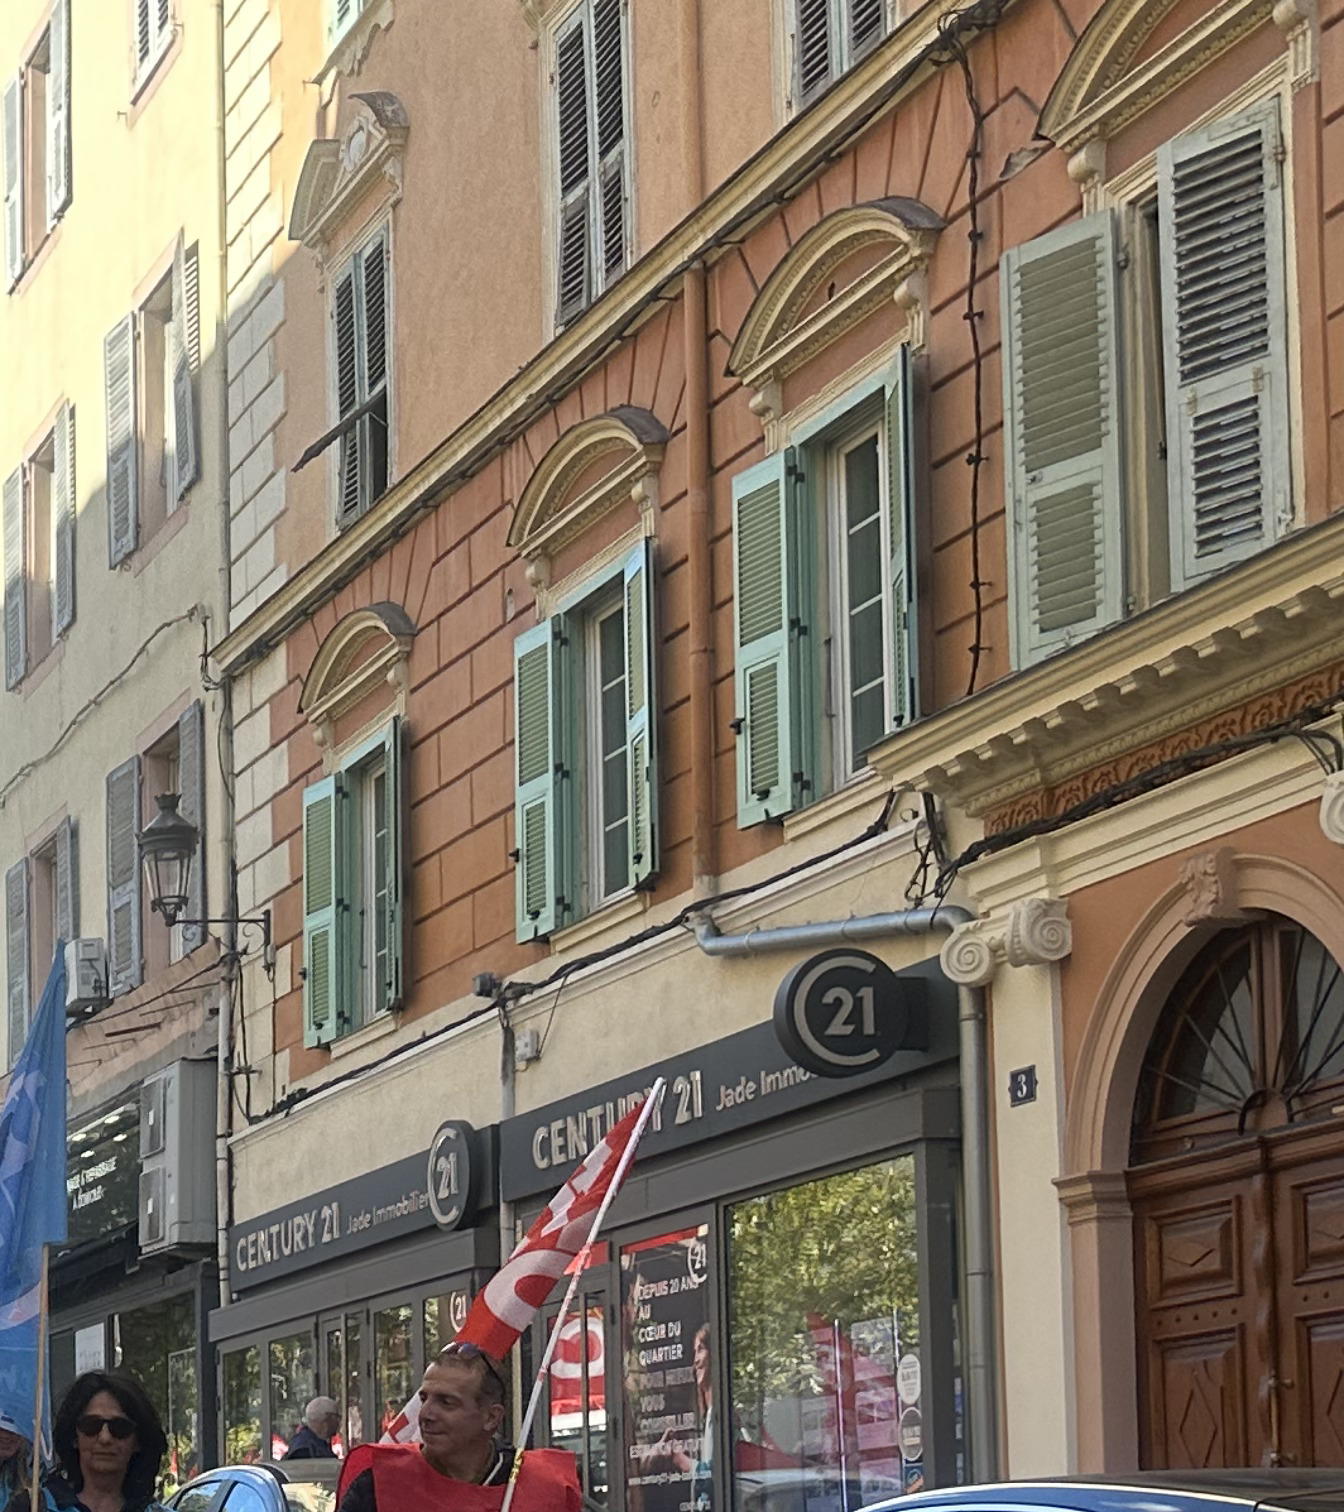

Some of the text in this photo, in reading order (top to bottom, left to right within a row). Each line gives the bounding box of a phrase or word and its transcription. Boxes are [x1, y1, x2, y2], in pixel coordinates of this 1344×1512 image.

[673, 1070, 703, 1125] 21
[716, 1076, 757, 1112] Jade
[1016, 1073, 1028, 1099] 3
[236, 1209, 318, 1272] CENTURY
[321, 1202, 340, 1243] 21
[346, 1213, 371, 1235] Jade
[668, 1320, 681, 1338] DU
[638, 1343, 683, 1367] QUARTIER
